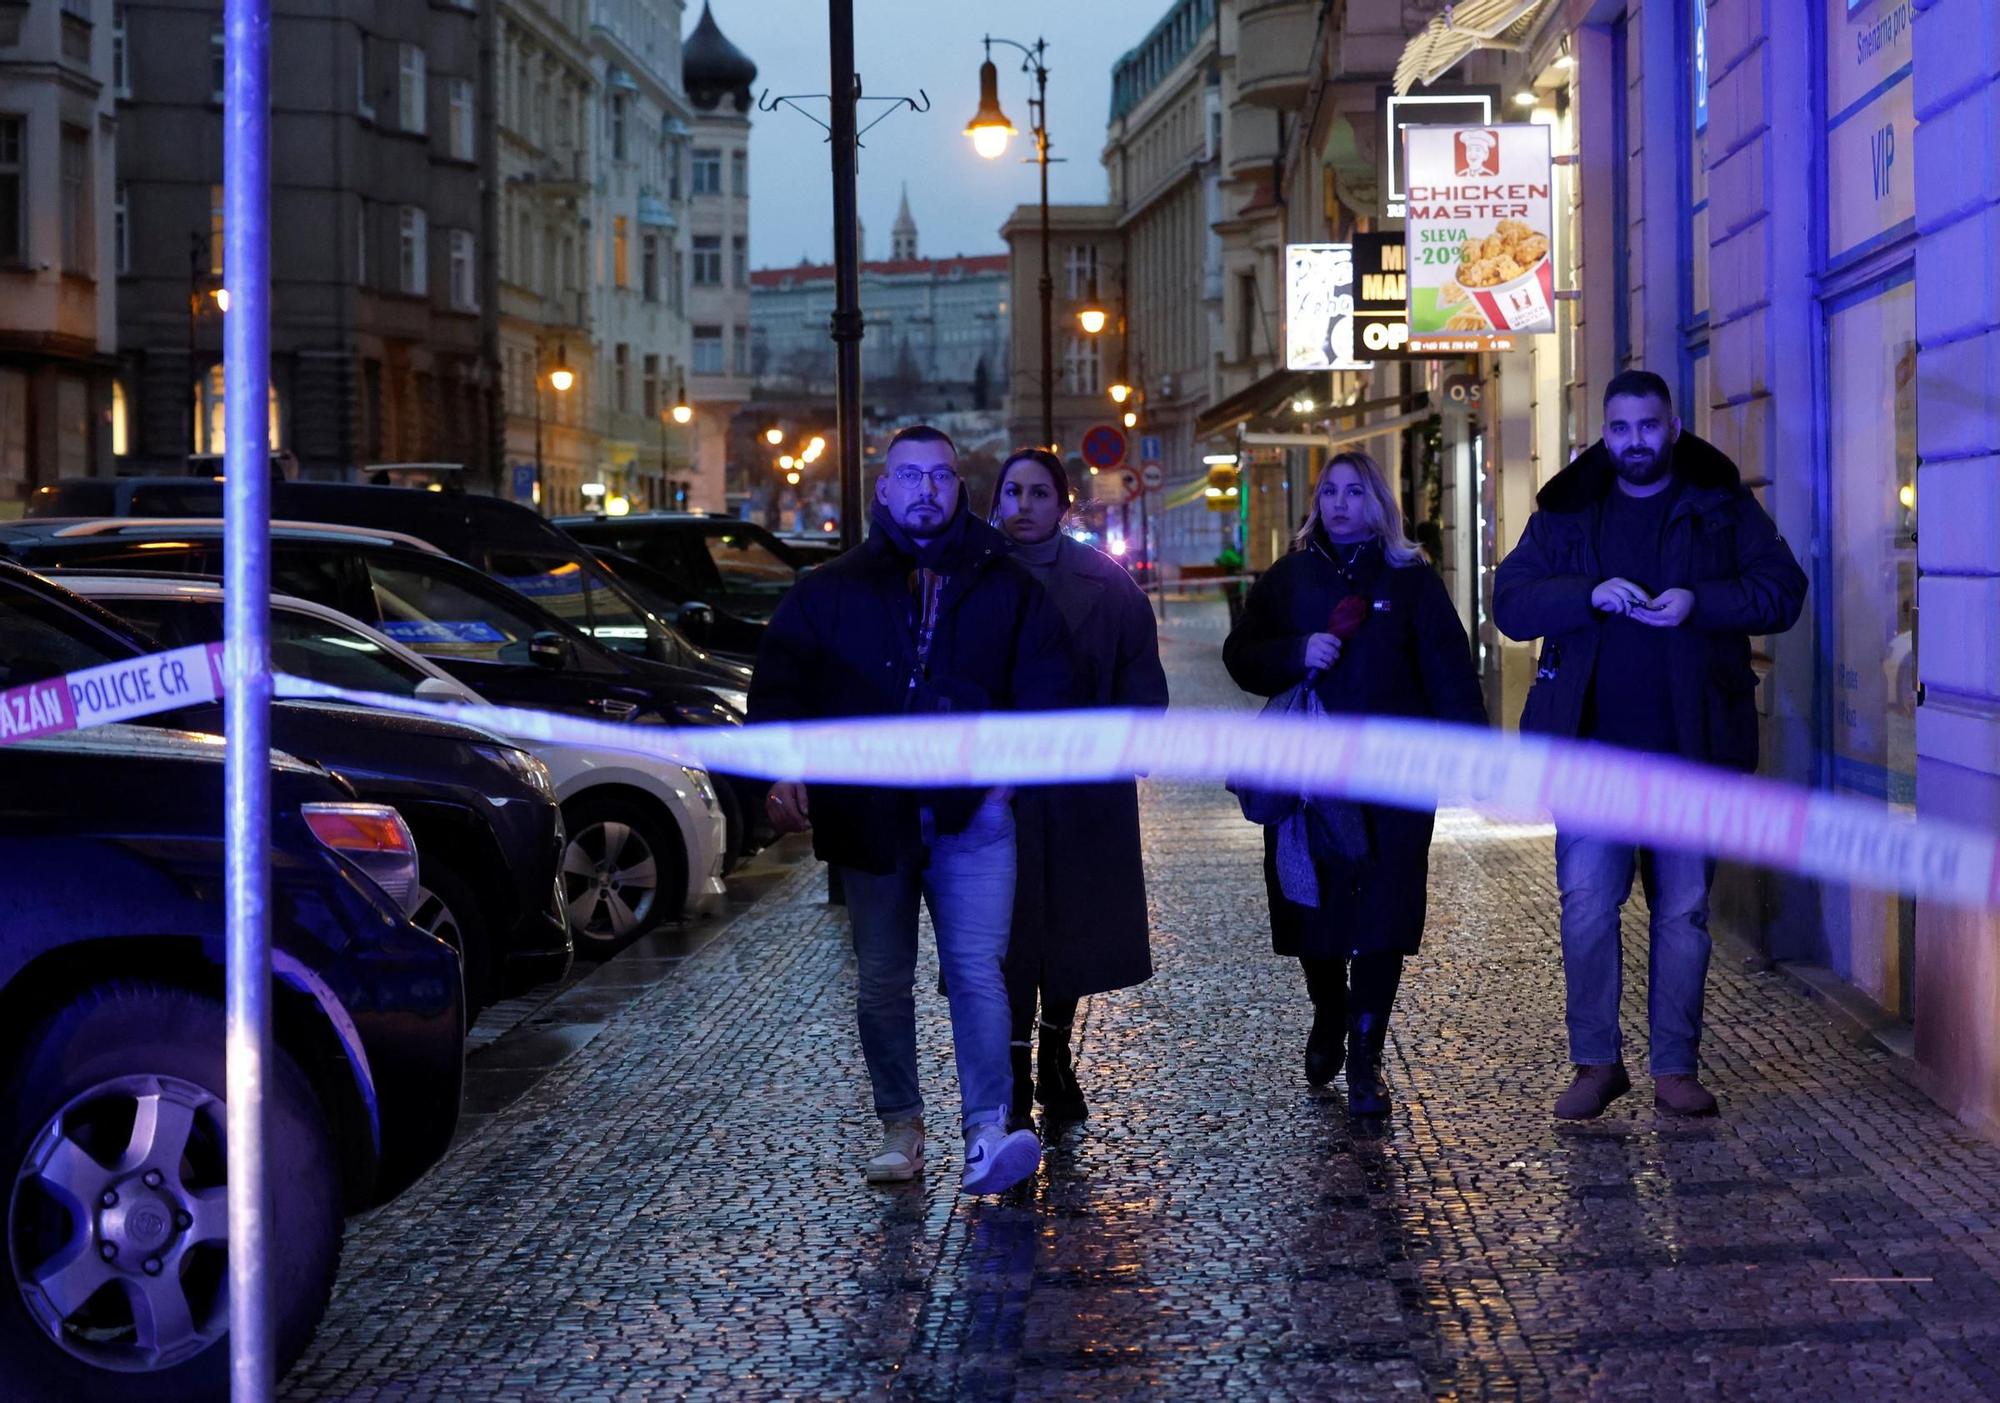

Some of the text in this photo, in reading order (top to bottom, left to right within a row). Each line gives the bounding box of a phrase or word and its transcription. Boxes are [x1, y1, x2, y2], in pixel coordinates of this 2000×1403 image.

[1893, 4, 1906, 47] pro
[1871, 122, 1895, 201] VIP
[1409, 184, 1549, 201] CHICKEN
[1409, 203, 1530, 220] MASTER
[1420, 228, 1469, 243] SLEVA
[1414, 246, 1471, 266] -20%
[70, 666, 156, 717] POLICIE
[159, 655, 190, 697] ČR
